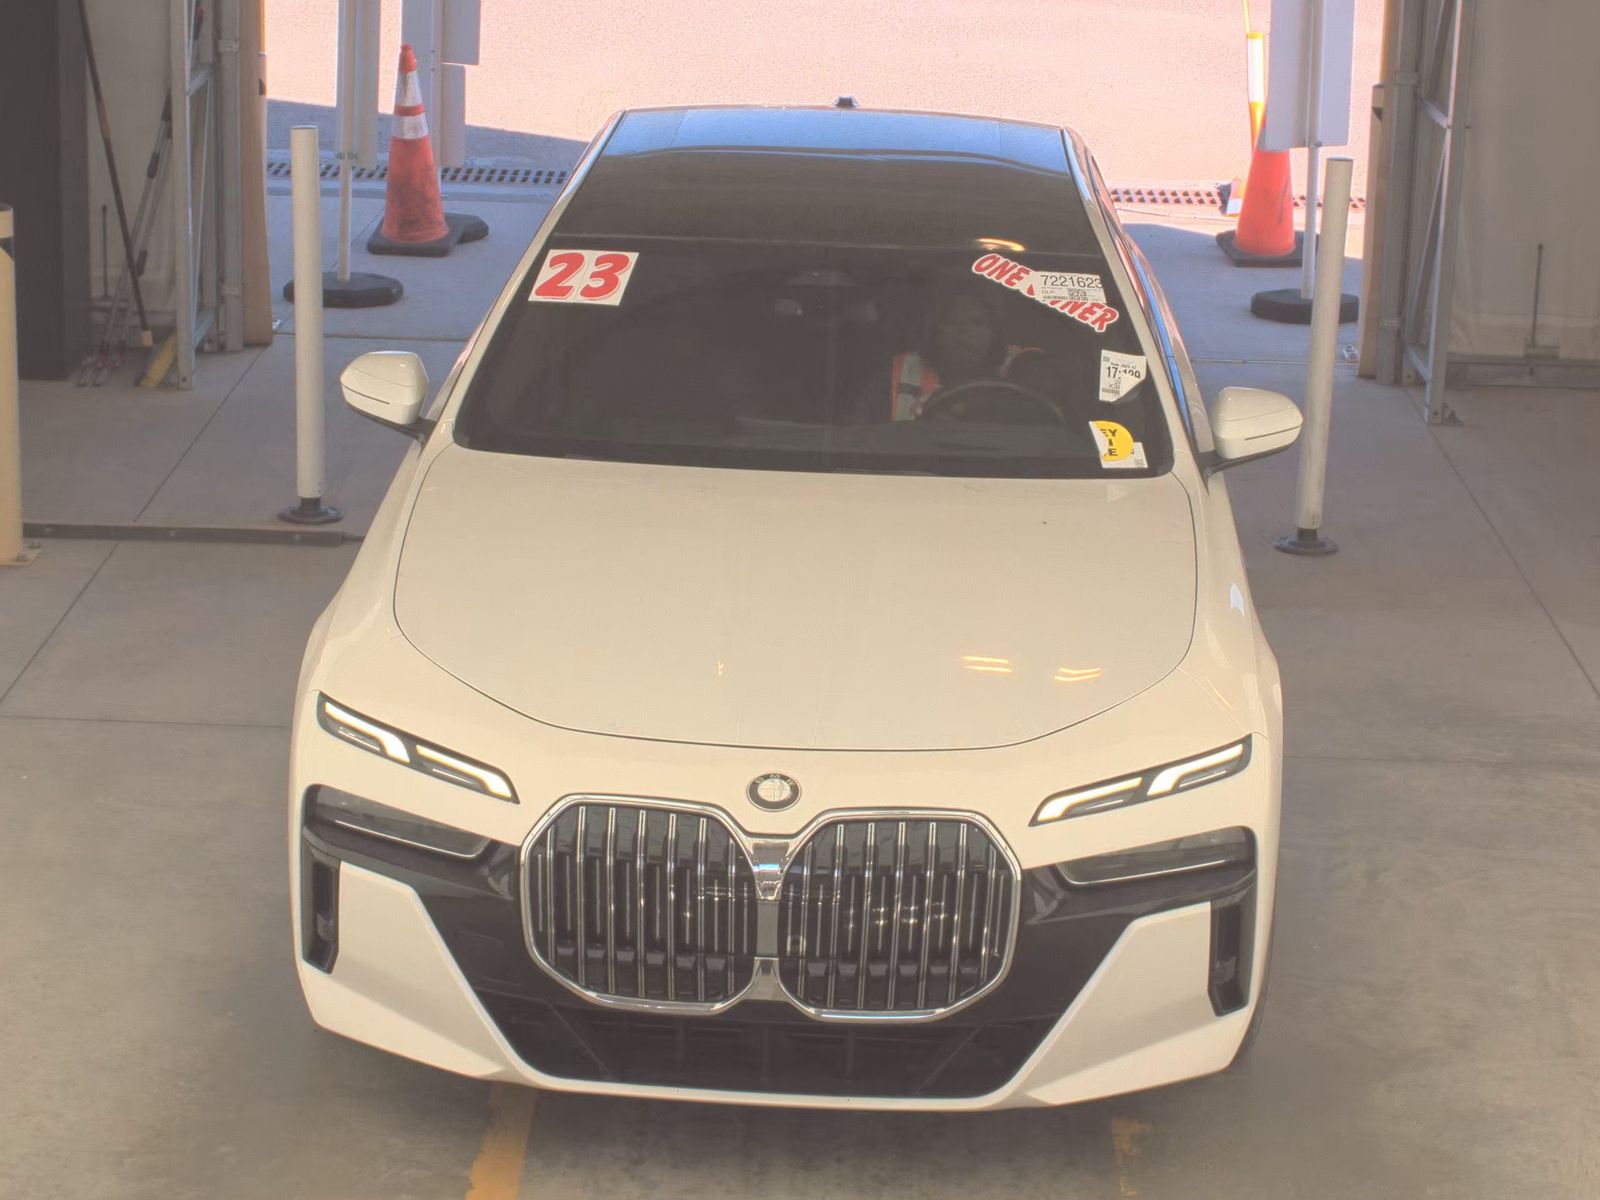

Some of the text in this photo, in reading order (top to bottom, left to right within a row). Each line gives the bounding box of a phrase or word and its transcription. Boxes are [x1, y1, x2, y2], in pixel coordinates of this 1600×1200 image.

[534, 252, 630, 300] 23
[973, 255, 1030, 286] ONE
[1040, 275, 1103, 289] 7221623
